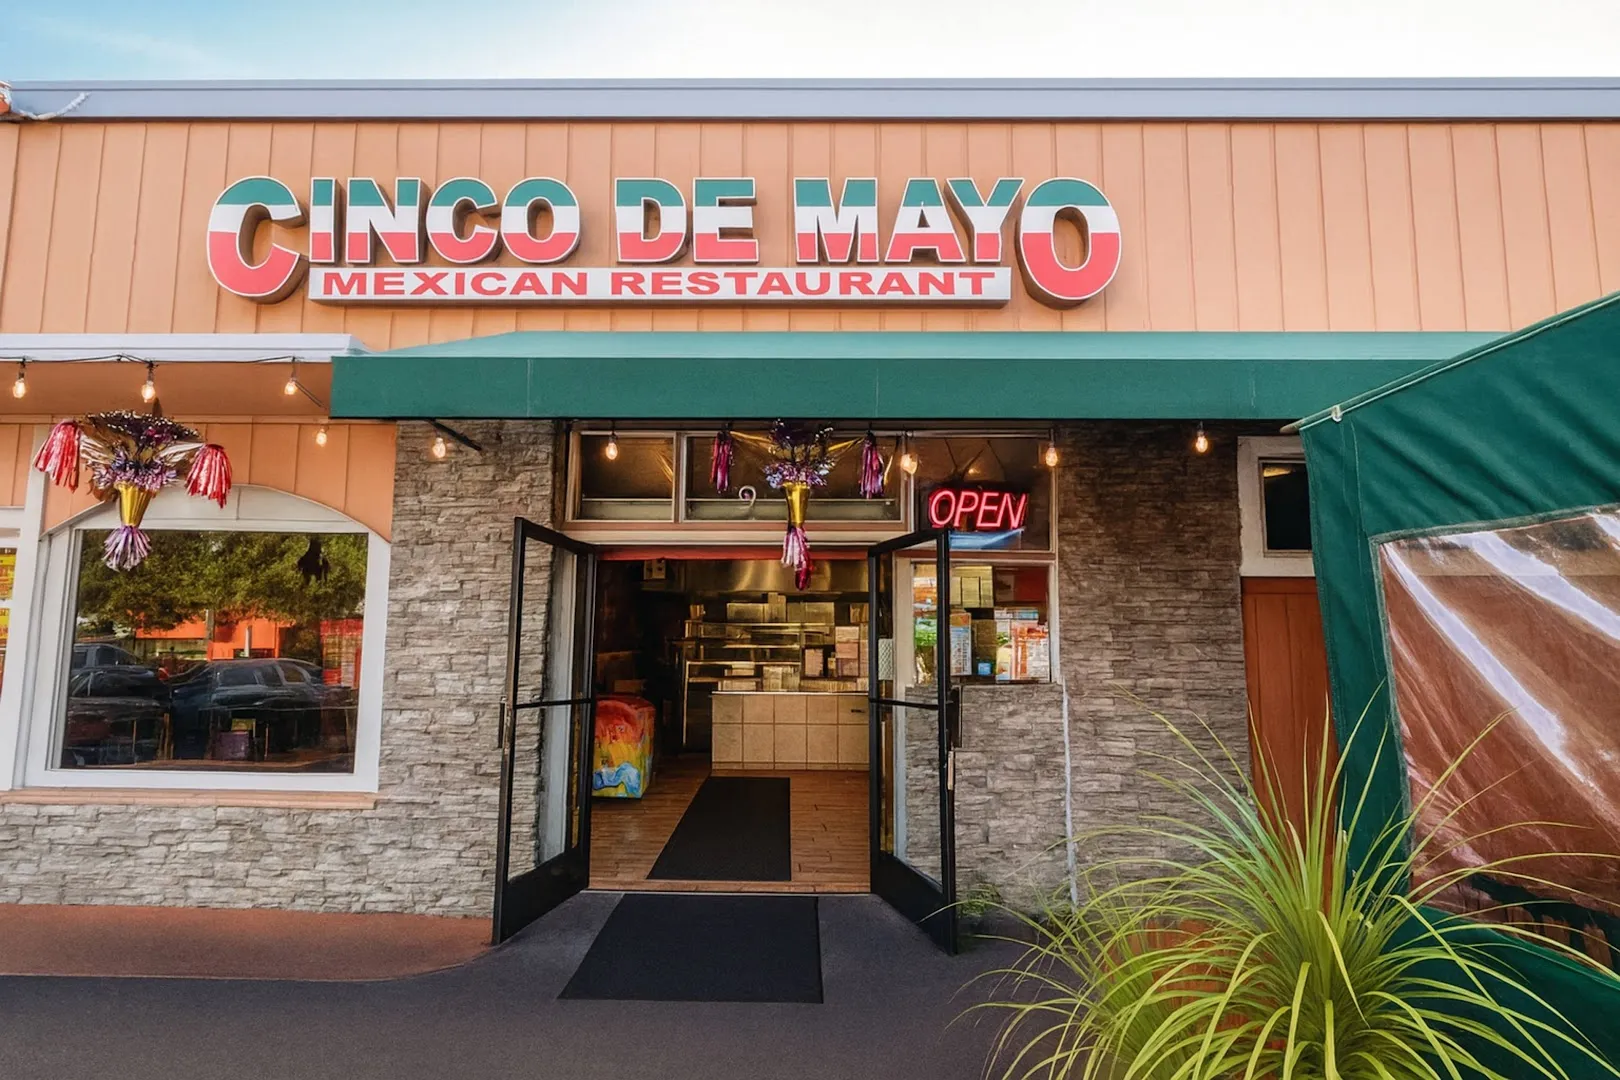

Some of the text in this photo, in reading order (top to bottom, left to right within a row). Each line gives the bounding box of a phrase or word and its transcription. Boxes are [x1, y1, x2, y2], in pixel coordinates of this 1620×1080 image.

[207, 176, 1122, 300] CINCO DE MAYO
[322, 271, 996, 296] MEXICAN RESTAURANT
[928, 488, 1028, 528] OPEN
